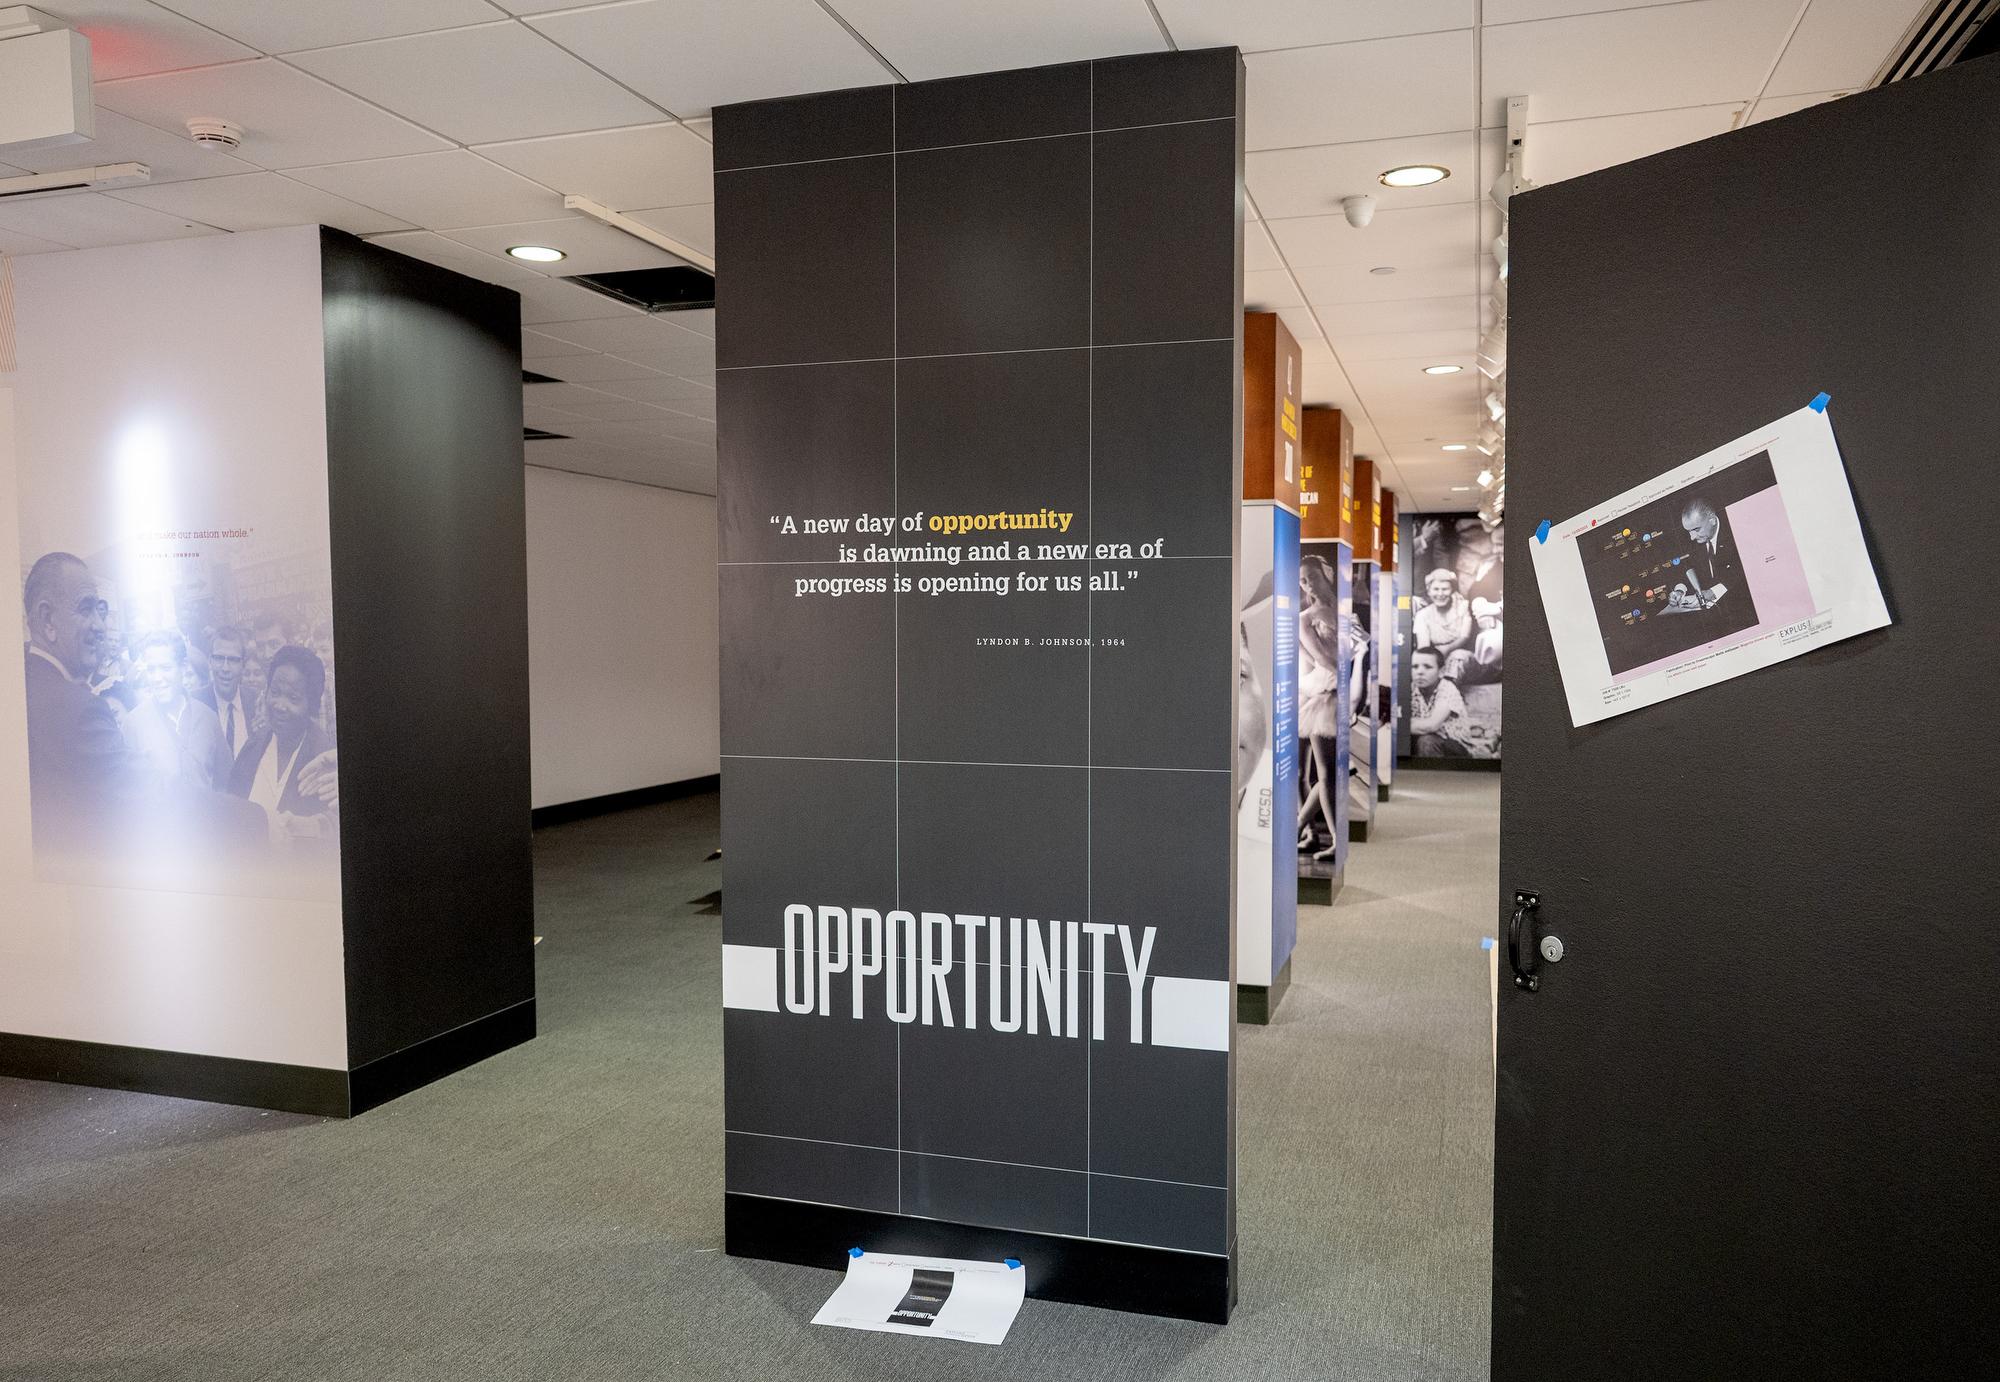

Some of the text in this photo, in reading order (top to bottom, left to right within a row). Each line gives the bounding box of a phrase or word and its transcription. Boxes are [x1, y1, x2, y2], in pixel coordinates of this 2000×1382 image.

[770, 508, 1073, 536] “A new day of opportunity
[177, 532, 192, 540] our
[193, 529, 220, 539] nation
[839, 538, 1164, 566] is dawning and a new era of
[795, 570, 1139, 597] progress is opening for us all.”
[1779, 622, 1808, 638] EXPLUS
[976, 638, 1126, 648] LYNDON B. JOHNSON, 1964
[784, 903, 1157, 1045] OPPORTUNITY
[897, 1309, 933, 1320] OPPORTUNITY
